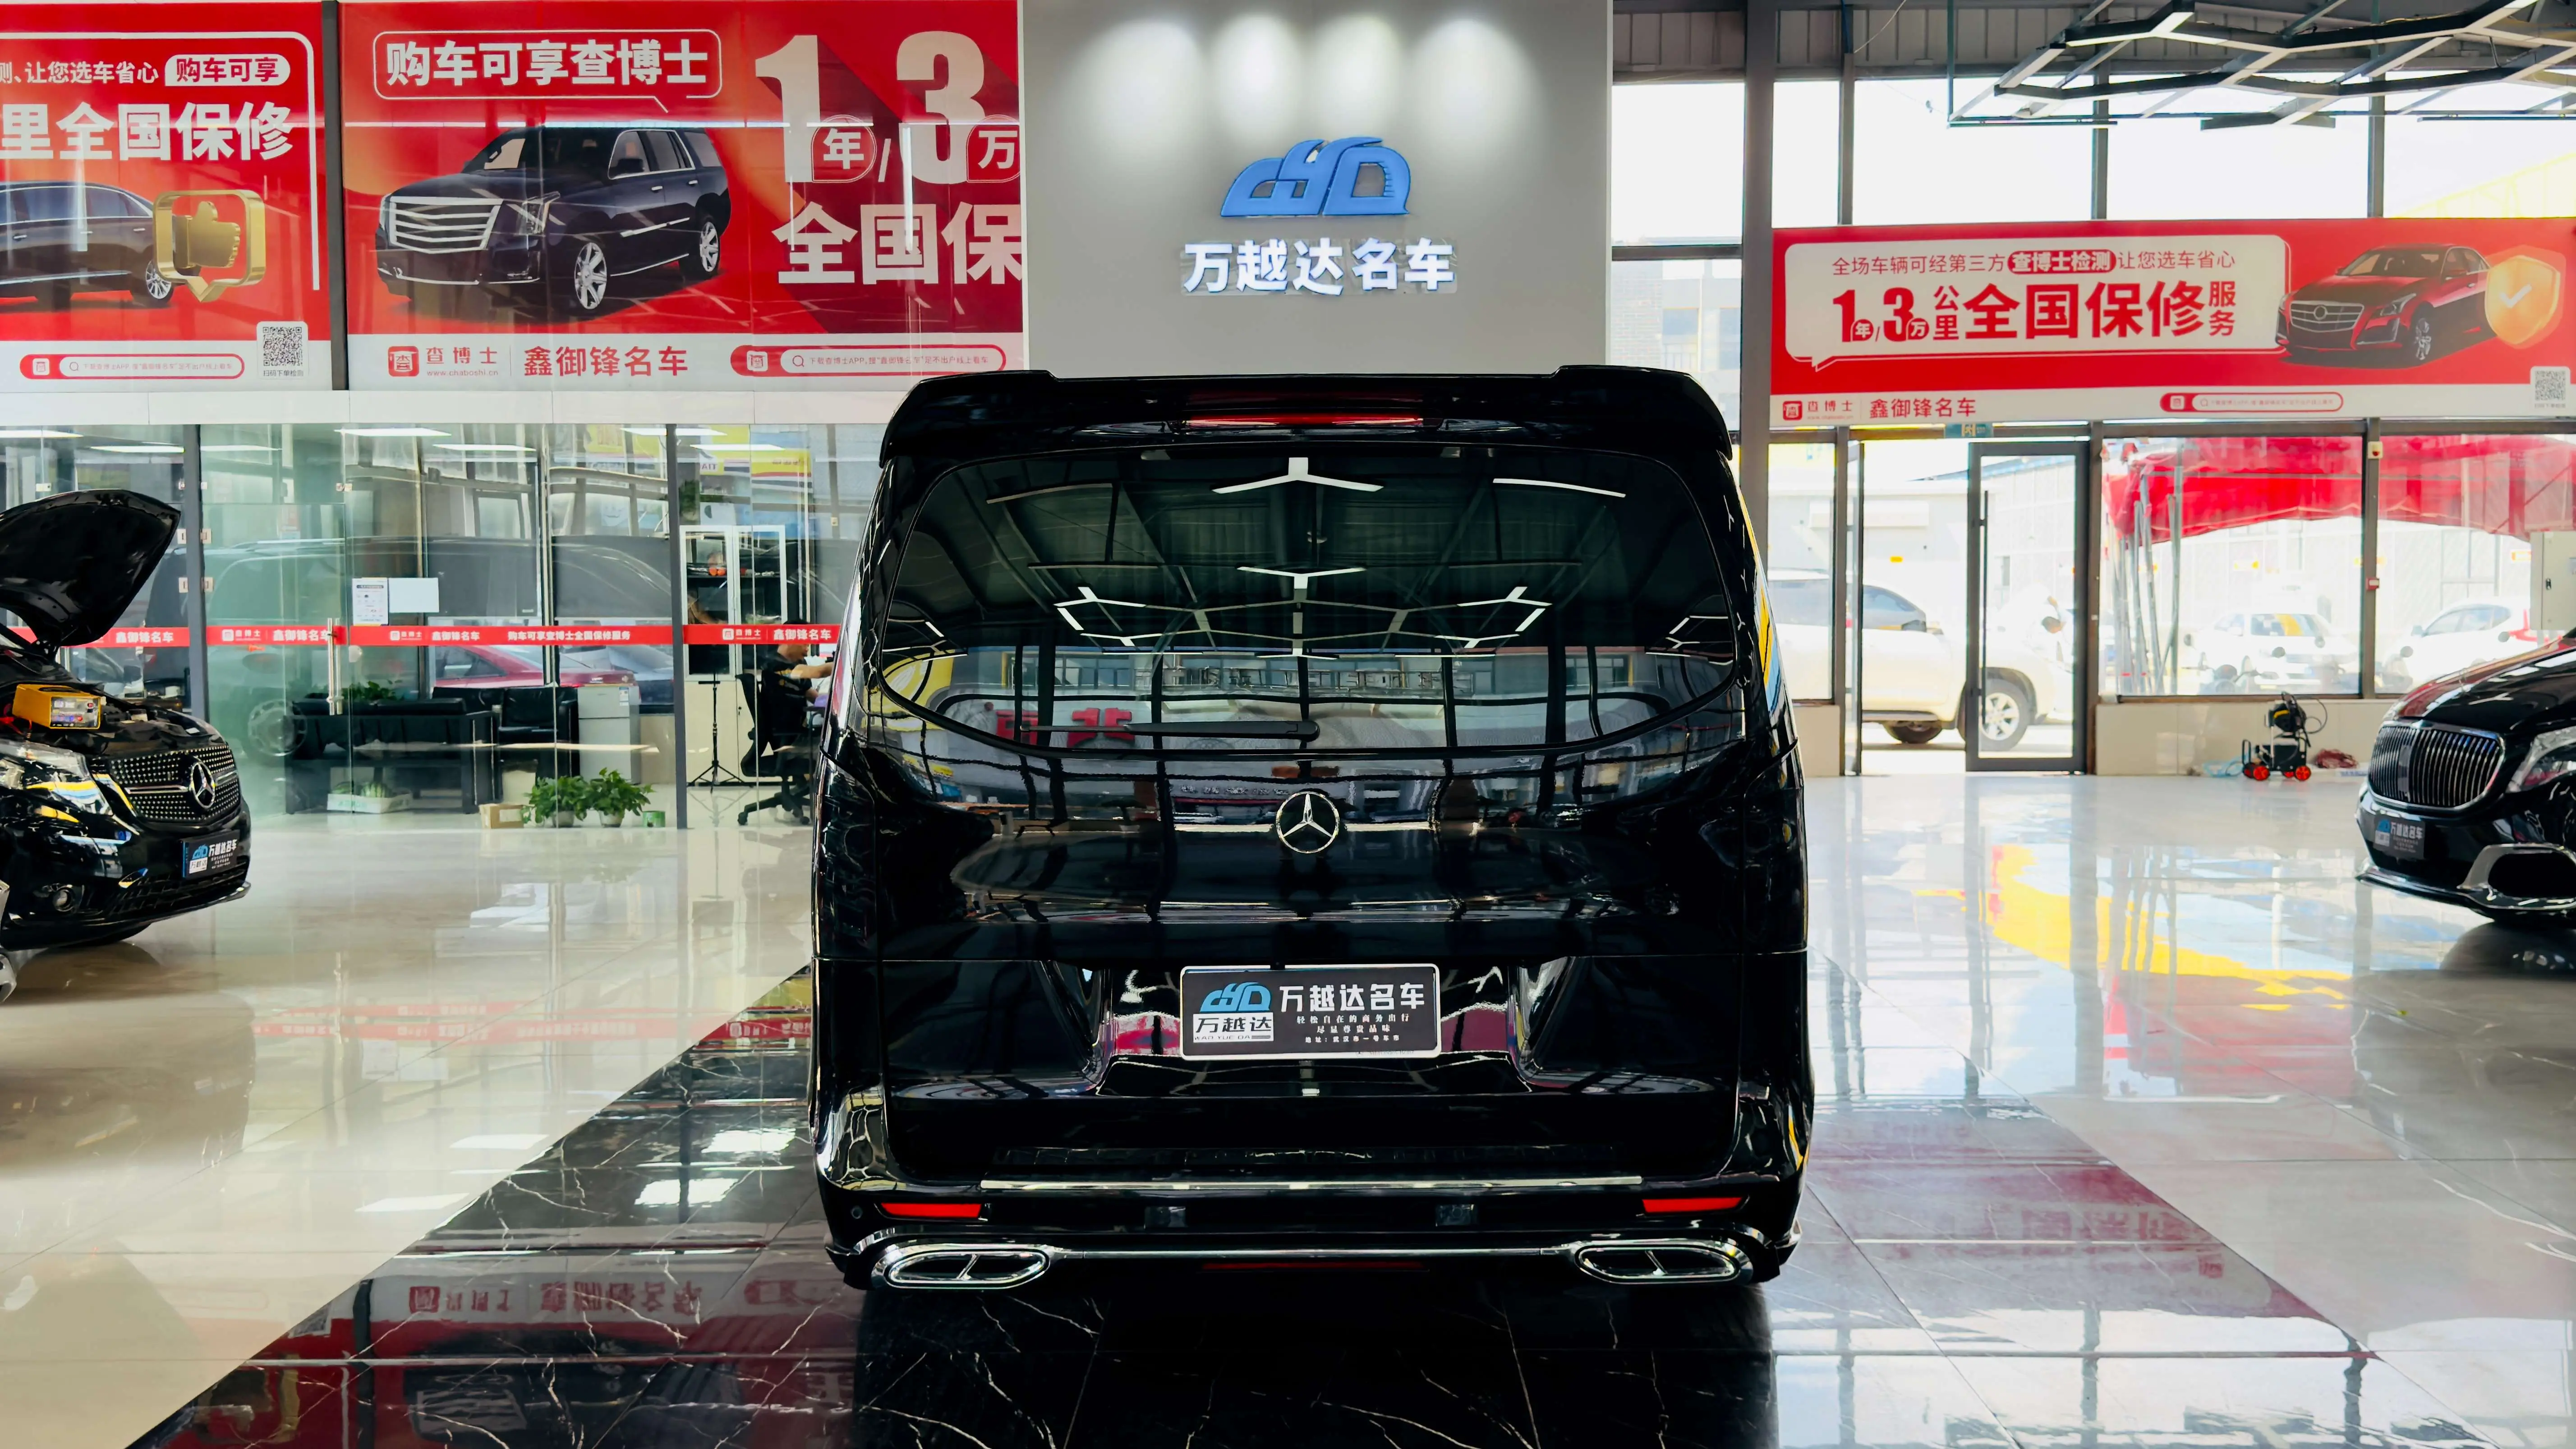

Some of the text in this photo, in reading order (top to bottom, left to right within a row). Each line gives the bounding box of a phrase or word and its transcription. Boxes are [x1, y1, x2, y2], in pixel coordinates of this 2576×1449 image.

[176, 57, 280, 82] 购车可享
[386, 39, 708, 86] 购车可享查博士
[0, 101, 294, 161] 里全国保修
[772, 201, 1022, 285] 全国保
[1184, 237, 1454, 295] 万越达名车
[1833, 250, 2236, 276] 全场车辆可经第三方 查博士检测 让您选车省心
[1963, 281, 2205, 340] 全国保修
[2208, 281, 2236, 337] 服务
[426, 345, 688, 377] 查博士 鑫御锋名车
[1870, 398, 1976, 419] 鑫御锋名车
[773, 629, 832, 640] 鑫御锋名车
[1279, 983, 1425, 1013] 万越达名车
[1196, 1017, 1272, 1033] 万越达
[1297, 1013, 1409, 1024] 轻松自在的商务出行
[1316, 1024, 1390, 1034] 尽显尊贵品味
